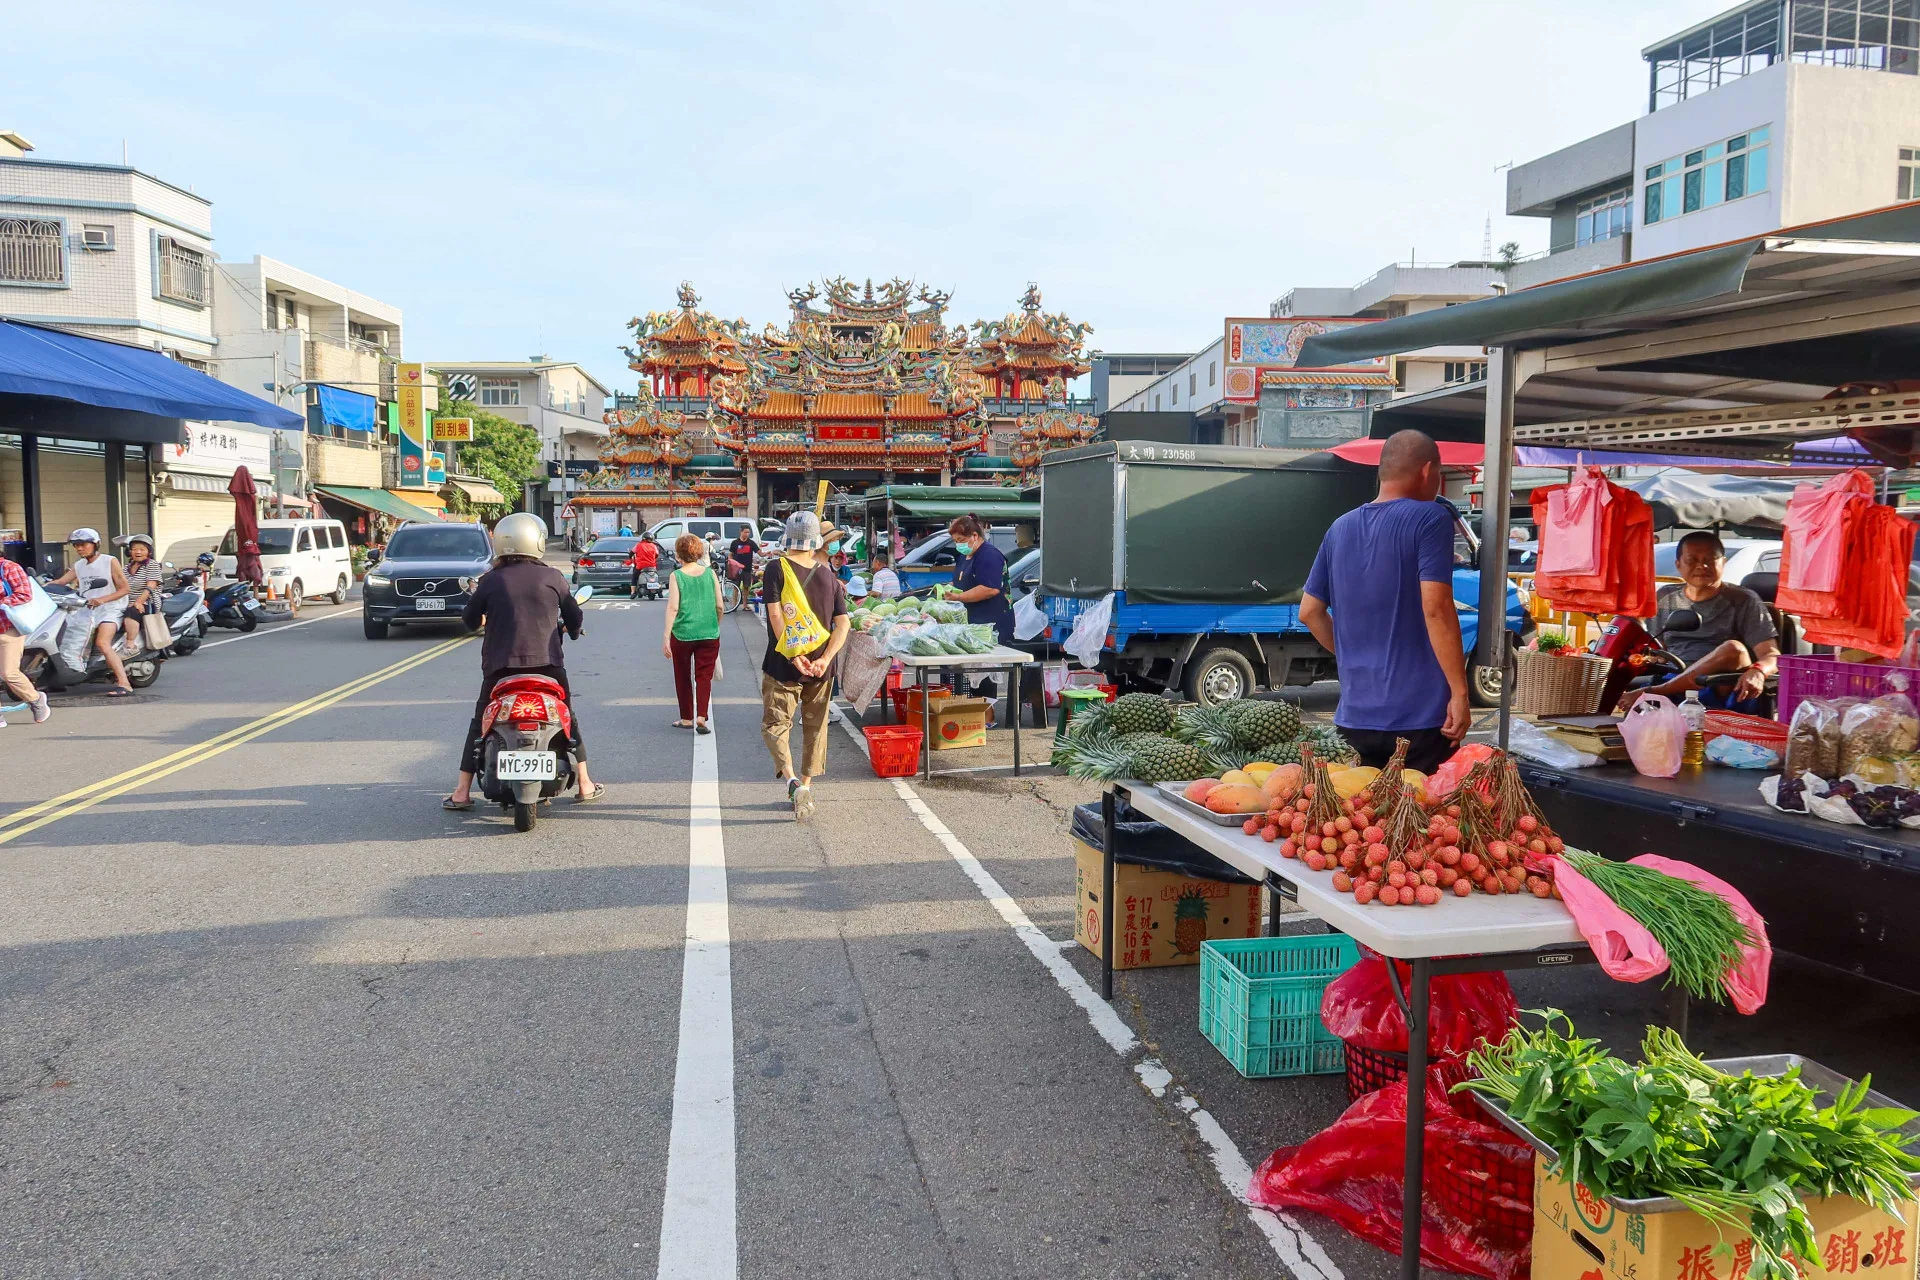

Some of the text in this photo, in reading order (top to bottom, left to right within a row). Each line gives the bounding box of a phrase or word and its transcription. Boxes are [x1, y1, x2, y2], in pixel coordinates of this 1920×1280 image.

[406, 388, 416, 428] 公益彩券
[435, 422, 469, 437] 刮刮樂
[1129, 445, 1196, 461] 大明 230568
[1541, 955, 1569, 963] LIFETIME
[1675, 1225, 1908, 1280] 振銷班
